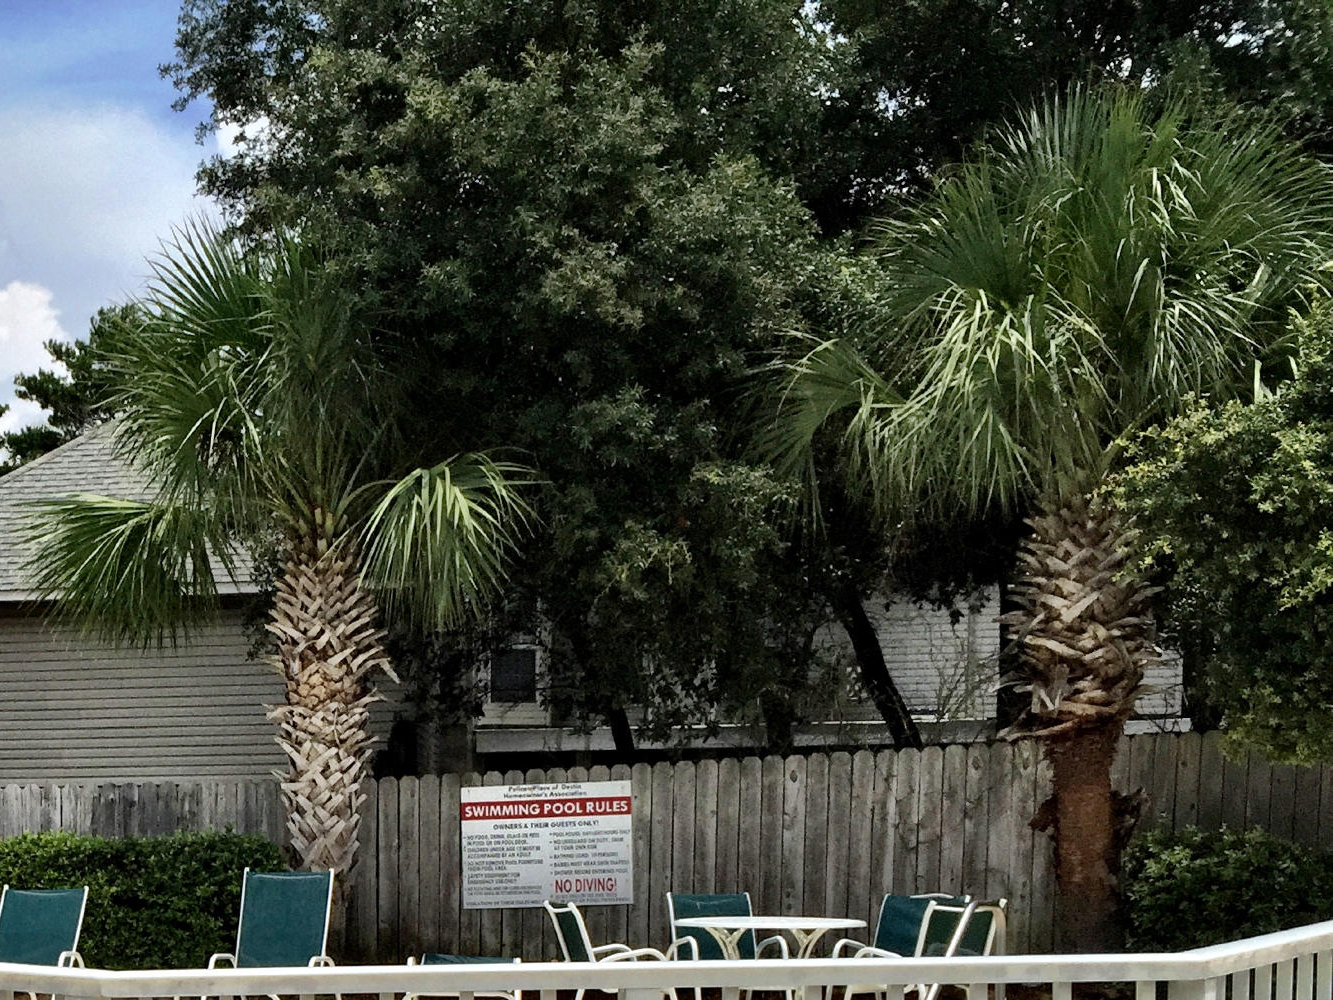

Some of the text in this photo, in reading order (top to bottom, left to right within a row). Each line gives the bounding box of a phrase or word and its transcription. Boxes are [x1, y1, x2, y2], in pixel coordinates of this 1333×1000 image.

[465, 801, 628, 817] SWIMMING POOL RULES
[555, 879, 572, 893] NO
[576, 878, 616, 892] DIVING!
